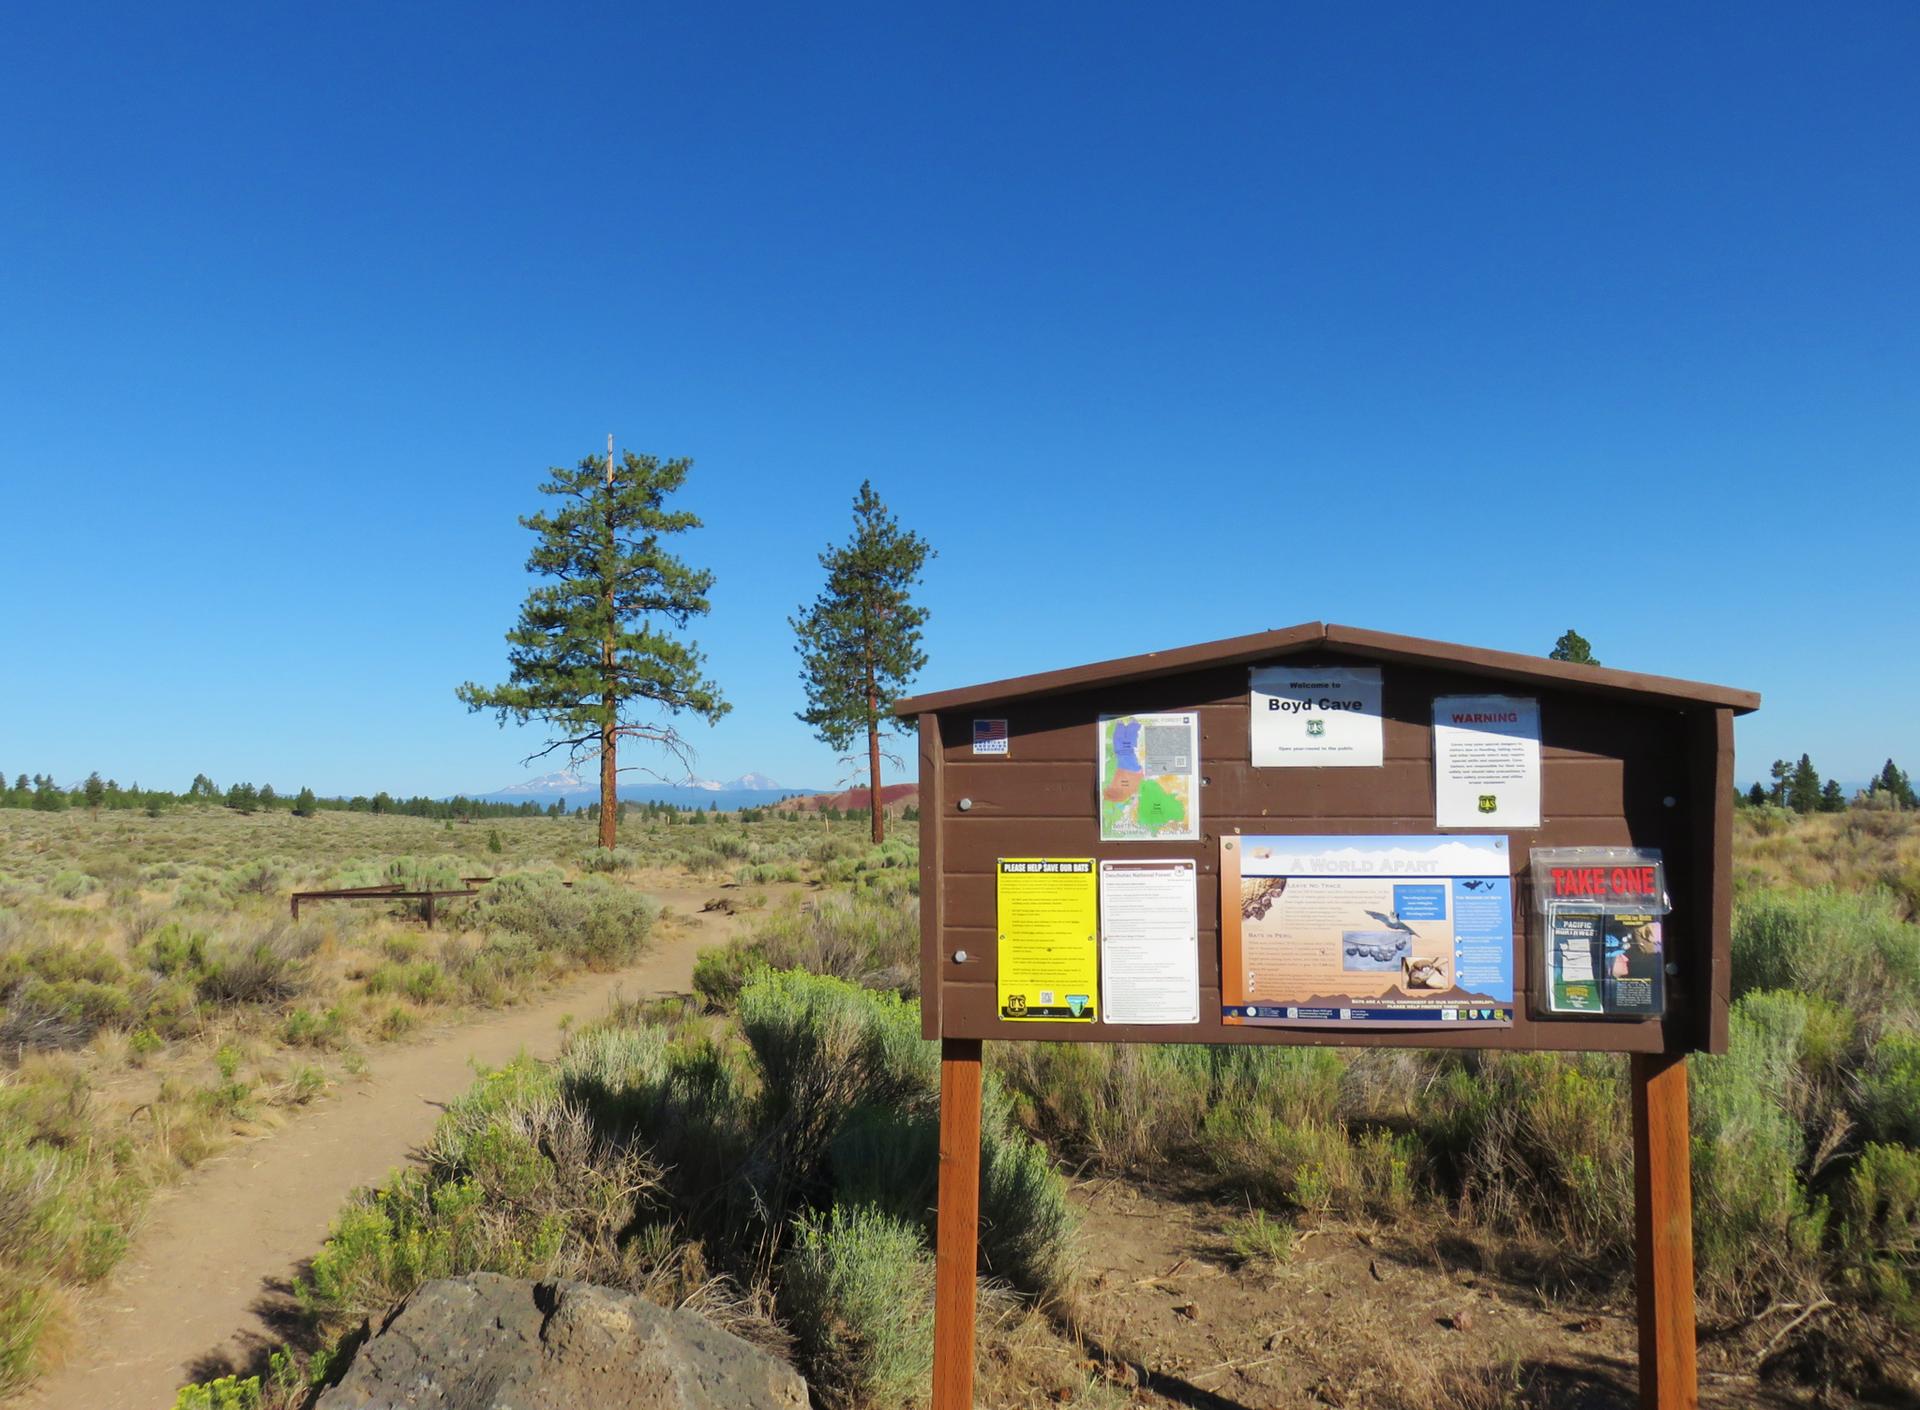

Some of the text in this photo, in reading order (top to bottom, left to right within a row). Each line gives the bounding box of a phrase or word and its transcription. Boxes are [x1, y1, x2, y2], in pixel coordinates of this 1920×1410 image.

[1268, 698, 1363, 714] Boyd Cave
[1452, 712, 1518, 724] WARNING
[1004, 863, 1090, 872] PLEASE HELP SAVE OUR BATS
[1290, 858, 1439, 872] A WORLD APART
[1552, 867, 1656, 895] TAKE ONE
[1563, 921, 1592, 929] PACIFIC
